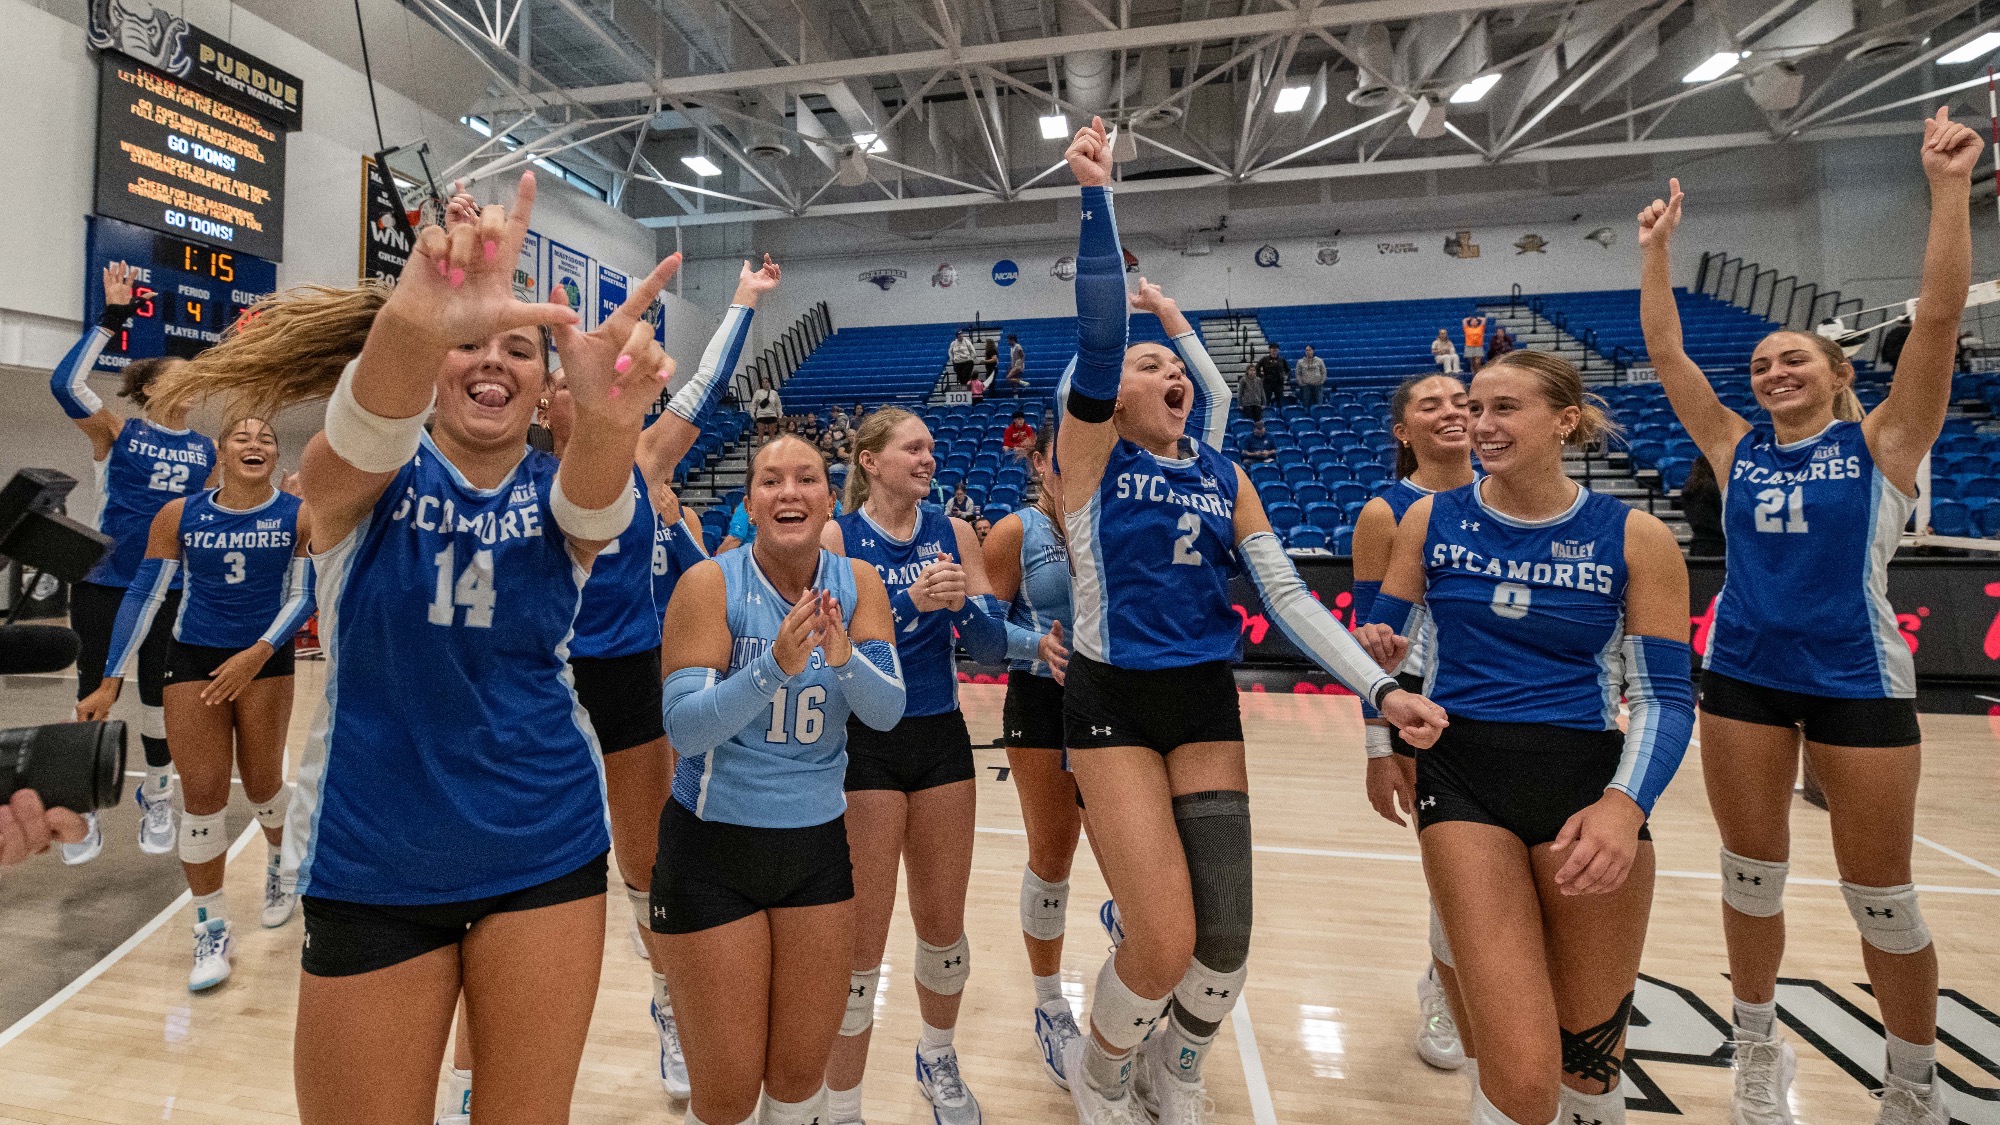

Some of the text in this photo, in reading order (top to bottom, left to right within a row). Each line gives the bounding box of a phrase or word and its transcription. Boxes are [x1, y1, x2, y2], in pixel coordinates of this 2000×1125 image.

[200, 44, 297, 105] PURDUE
[215, 71, 285, 110] FORT WAYNE
[167, 134, 189, 154] GO
[165, 209, 186, 229] GO
[184, 245, 234, 282] 1:15
[994, 271, 1019, 282] NCAA
[178, 284, 210, 300] PERIOD
[231, 289, 265, 306] GUES
[187, 301, 201, 322] 4
[164, 323, 199, 340] PLAYER
[1632, 371, 1657, 381] 103
[949, 393, 969, 405] 101
[128, 439, 207, 467] SYCAMORES
[148, 462, 190, 493] 22
[508, 480, 539, 504] ALLE
[1754, 485, 1809, 533] 21
[256, 518, 282, 530] VALLEY
[183, 531, 292, 549] SYCAMORES
[1171, 511, 1202, 566] 2
[1551, 541, 1595, 559] VALLEY
[223, 551, 246, 584] 3
[1430, 543, 1613, 594] SYCAMORES
[427, 541, 497, 629] 14
[765, 684, 827, 745] 16
